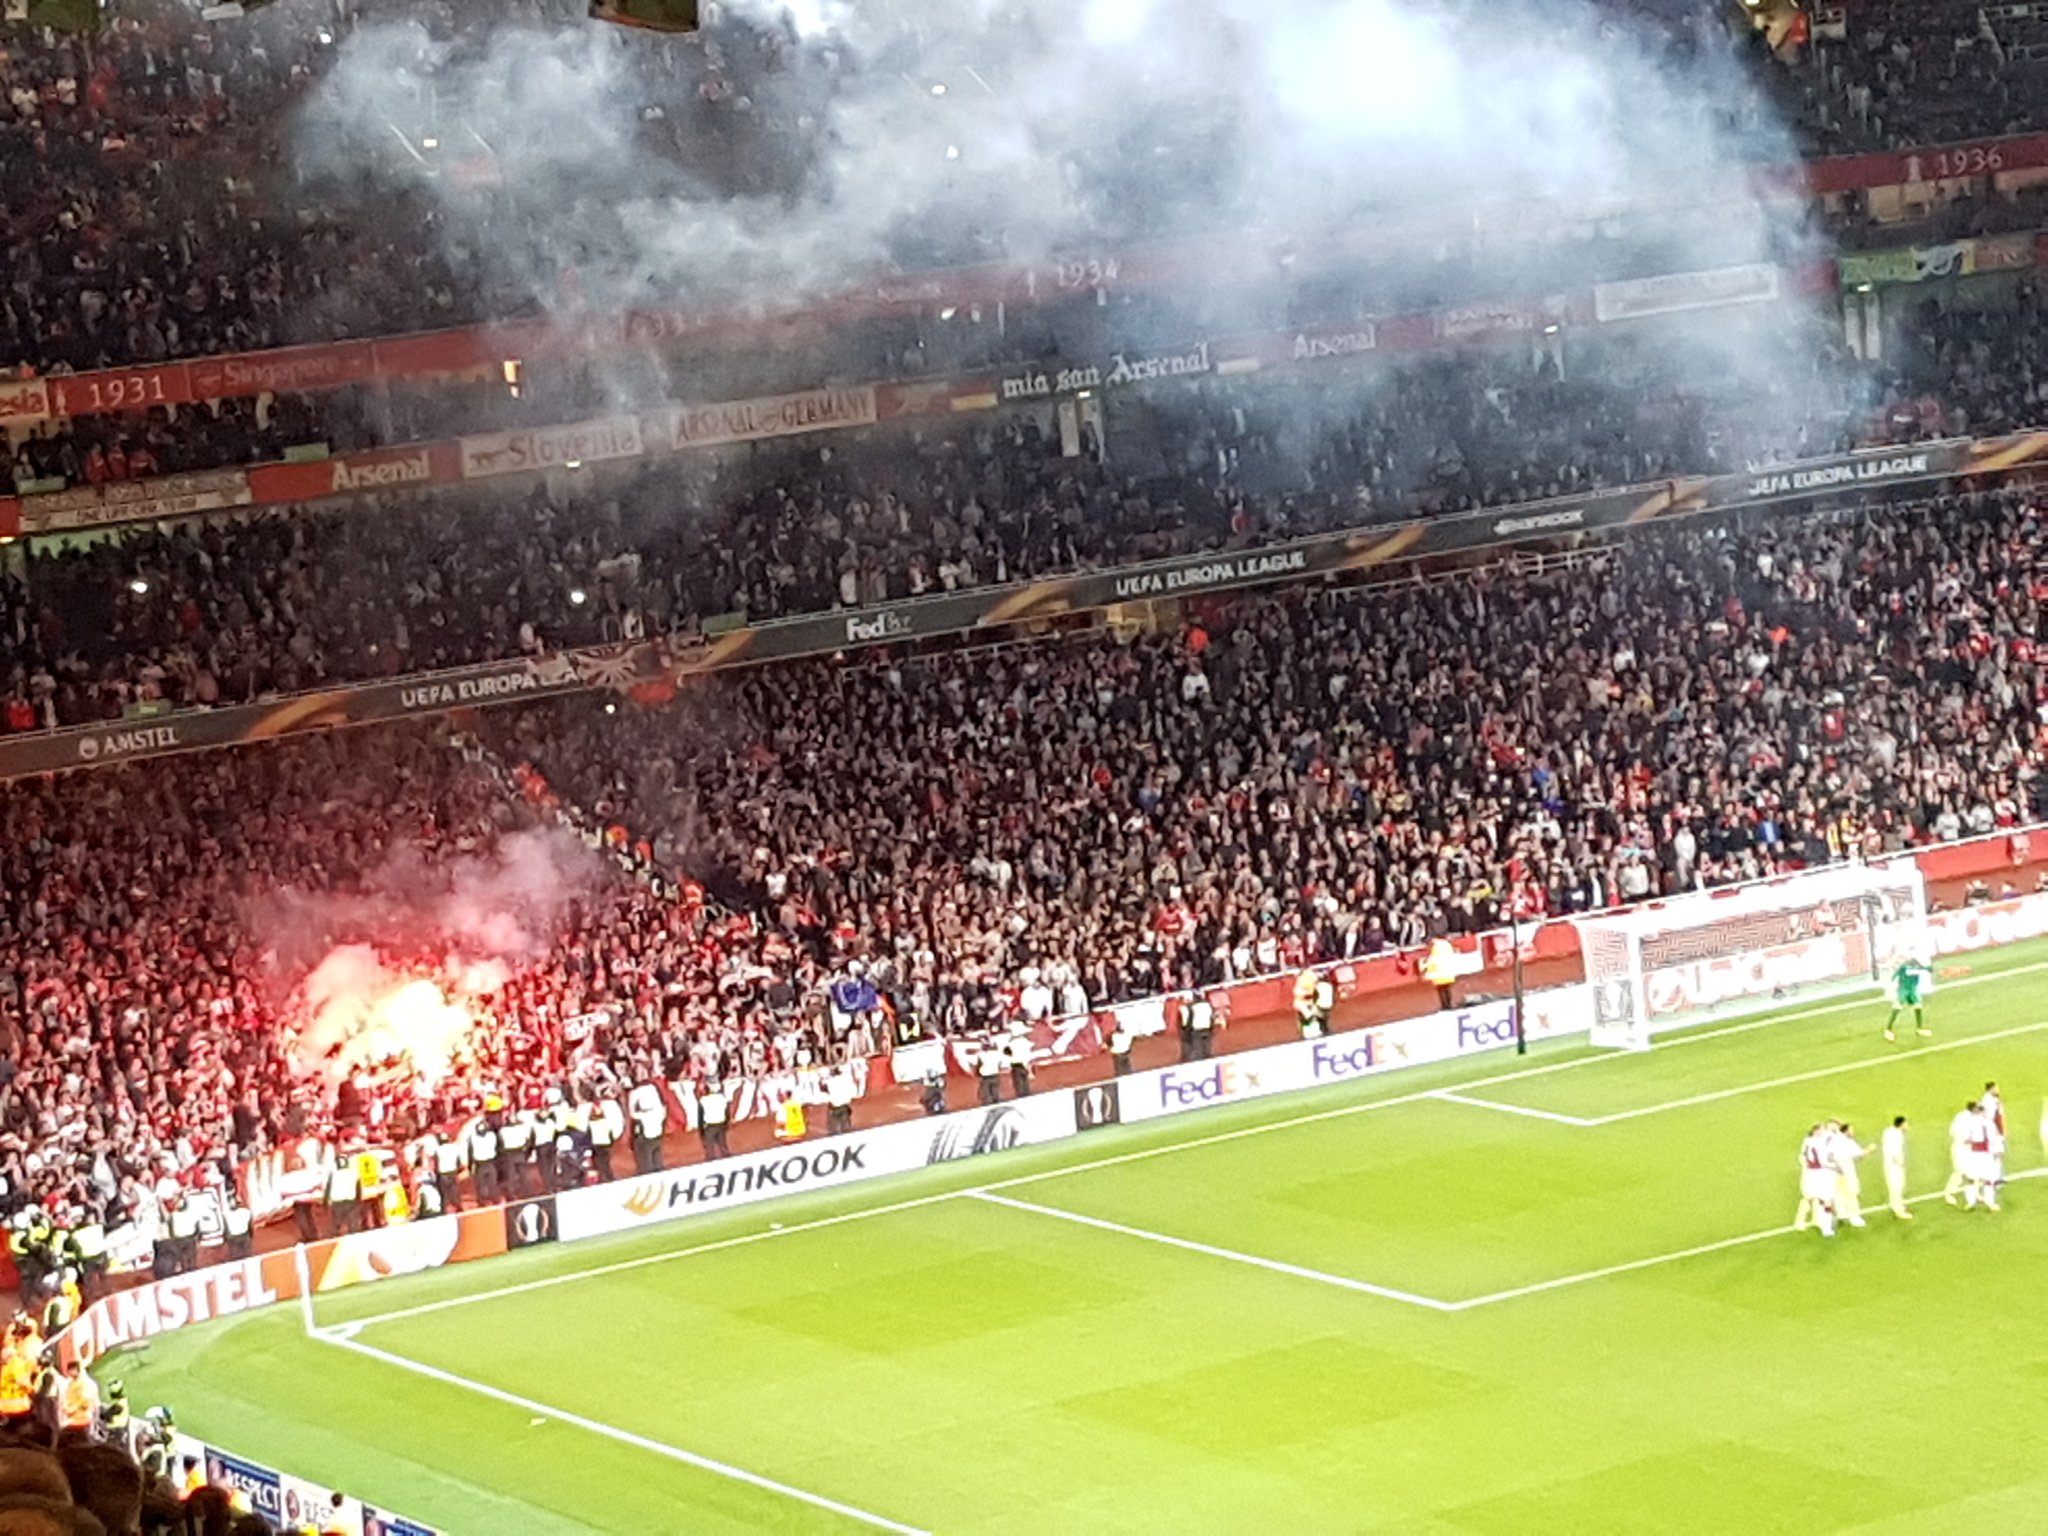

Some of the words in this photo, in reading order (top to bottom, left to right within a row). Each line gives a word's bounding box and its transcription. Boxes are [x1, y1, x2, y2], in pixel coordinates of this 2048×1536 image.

[1938, 145, 2003, 176] 1936
[89, 374, 165, 408] 1931
[332, 450, 431, 491] Arsenal
[1793, 464, 1855, 489] EUROPA
[1857, 455, 1928, 480] LEAGUE
[1116, 575, 1163, 596] UEFA
[1167, 561, 1235, 589] EUROPA
[1237, 551, 1307, 577] LEAGUE
[401, 683, 455, 709] UEFA
[458, 672, 535, 699] EUROPA
[103, 726, 180, 754] AMSTEL
[1312, 1030, 1411, 1078] FedEx
[1159, 1060, 1262, 1108] FedEx
[95, 1256, 277, 1357] AMSTEL
